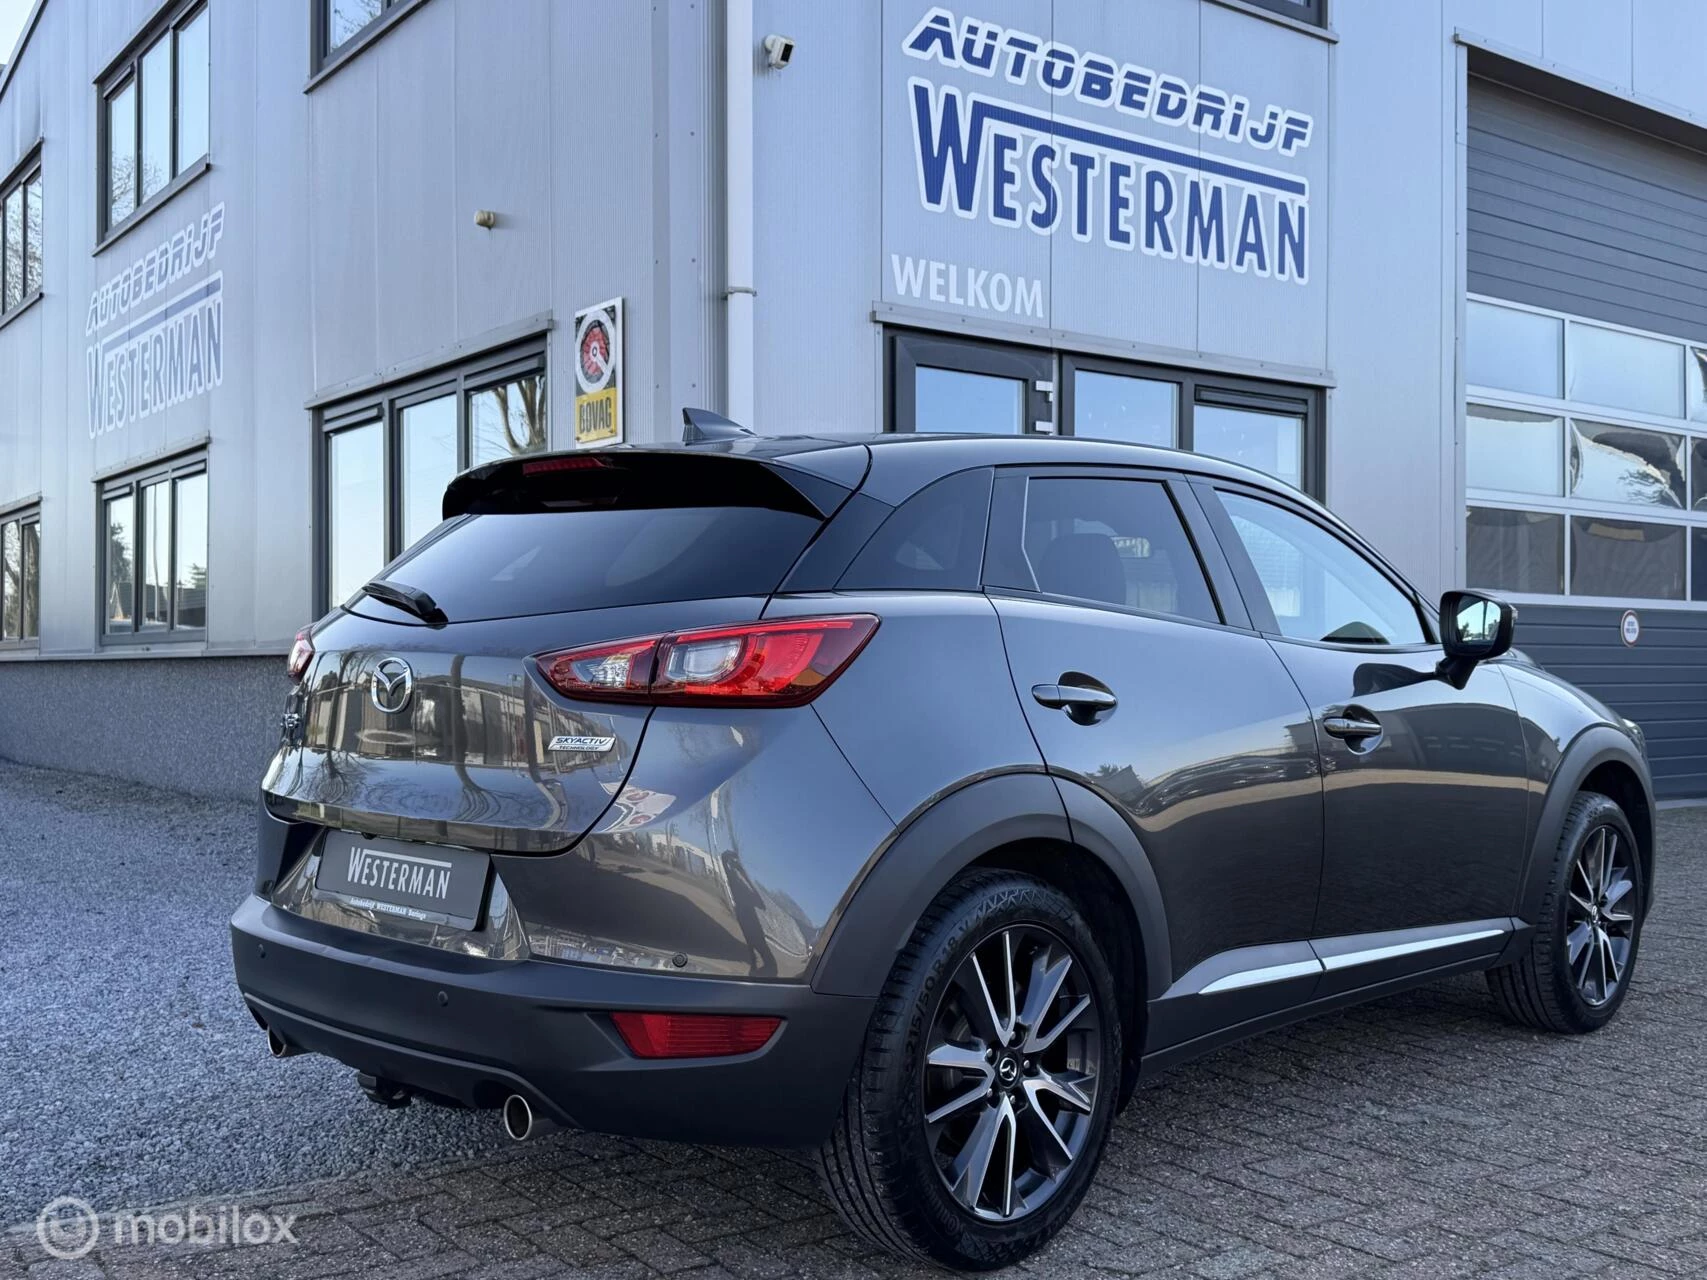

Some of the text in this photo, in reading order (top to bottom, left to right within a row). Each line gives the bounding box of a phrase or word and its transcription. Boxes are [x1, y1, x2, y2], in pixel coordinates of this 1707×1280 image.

[904, 9, 1311, 155] AUTOBEDRIJF
[909, 81, 1309, 282] WESTERMAN
[86, 201, 224, 336] AUTOBEDRIJF
[891, 254, 1043, 317] WELKOM
[86, 298, 223, 439] WESTERMAN
[579, 397, 612, 434] BOVAG
[348, 847, 451, 899] WESTERMAN
